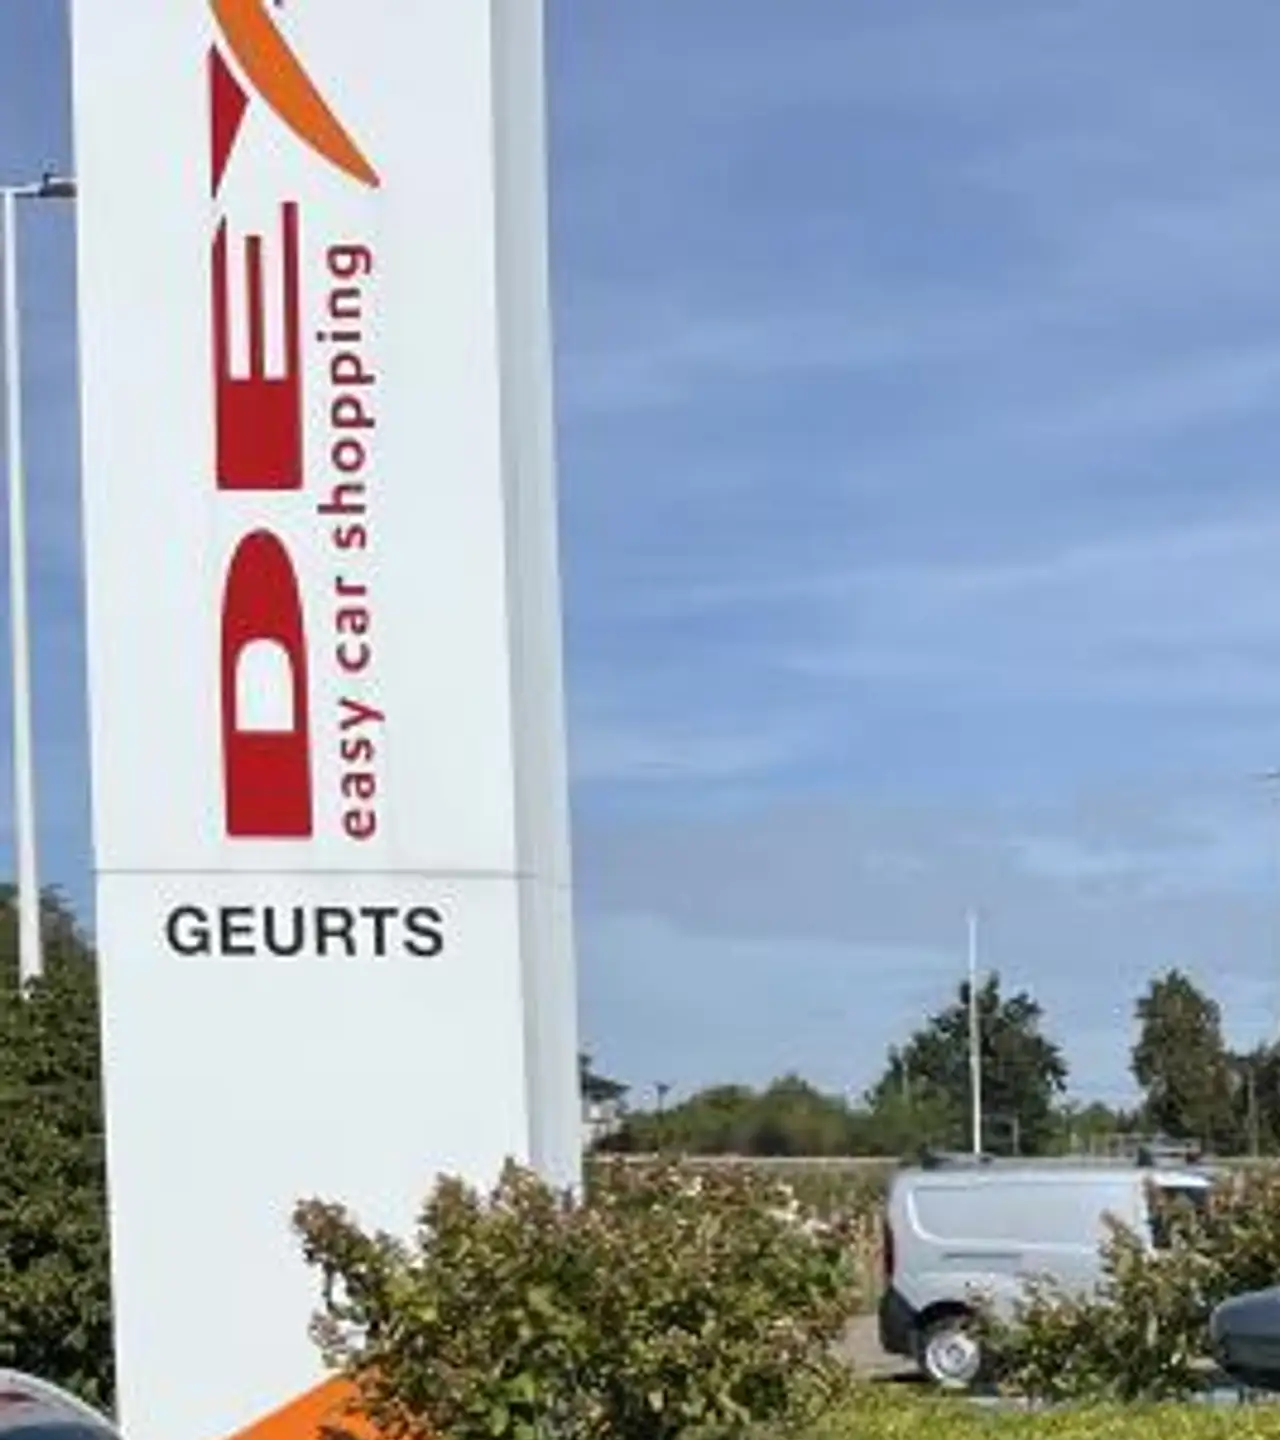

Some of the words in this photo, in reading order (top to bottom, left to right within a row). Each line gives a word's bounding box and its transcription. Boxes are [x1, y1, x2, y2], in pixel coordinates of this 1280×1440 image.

[316, 243, 379, 549] shopping
[334, 575, 369, 671] car
[340, 692, 385, 840] easy
[166, 905, 444, 957] GEURTS
